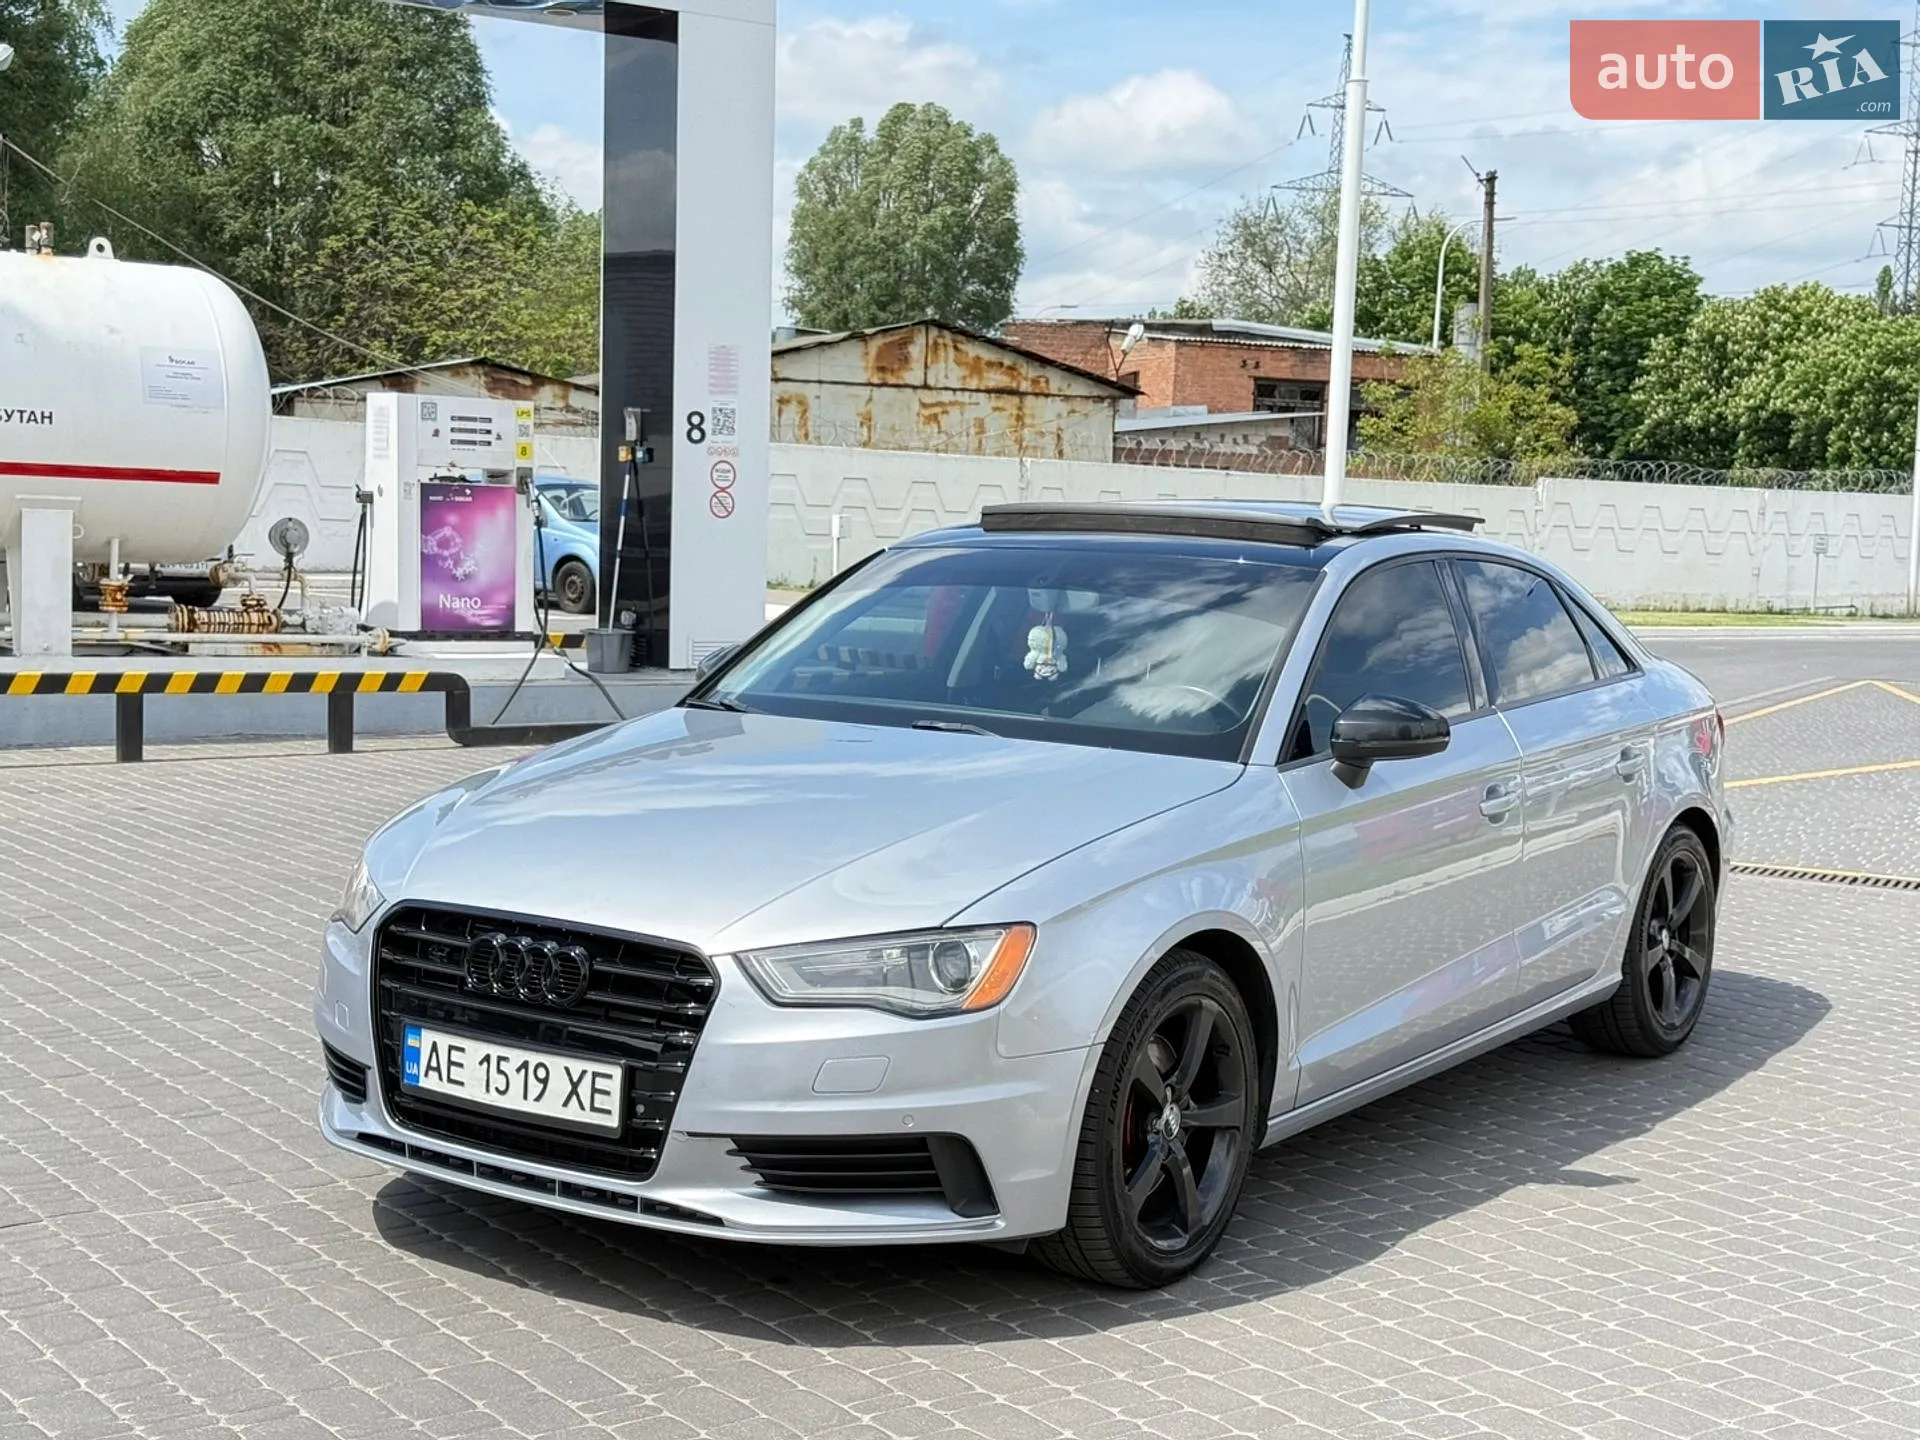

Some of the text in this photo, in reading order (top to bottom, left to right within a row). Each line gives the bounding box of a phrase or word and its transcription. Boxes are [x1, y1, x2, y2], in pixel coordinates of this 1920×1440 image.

[0, 408, 53, 425] УТАН
[686, 410, 706, 445] 8
[520, 446, 528, 457] 8
[439, 593, 482, 609] Nano
[406, 1062, 419, 1075] UA
[424, 1040, 614, 1115] AE 1519 XE
